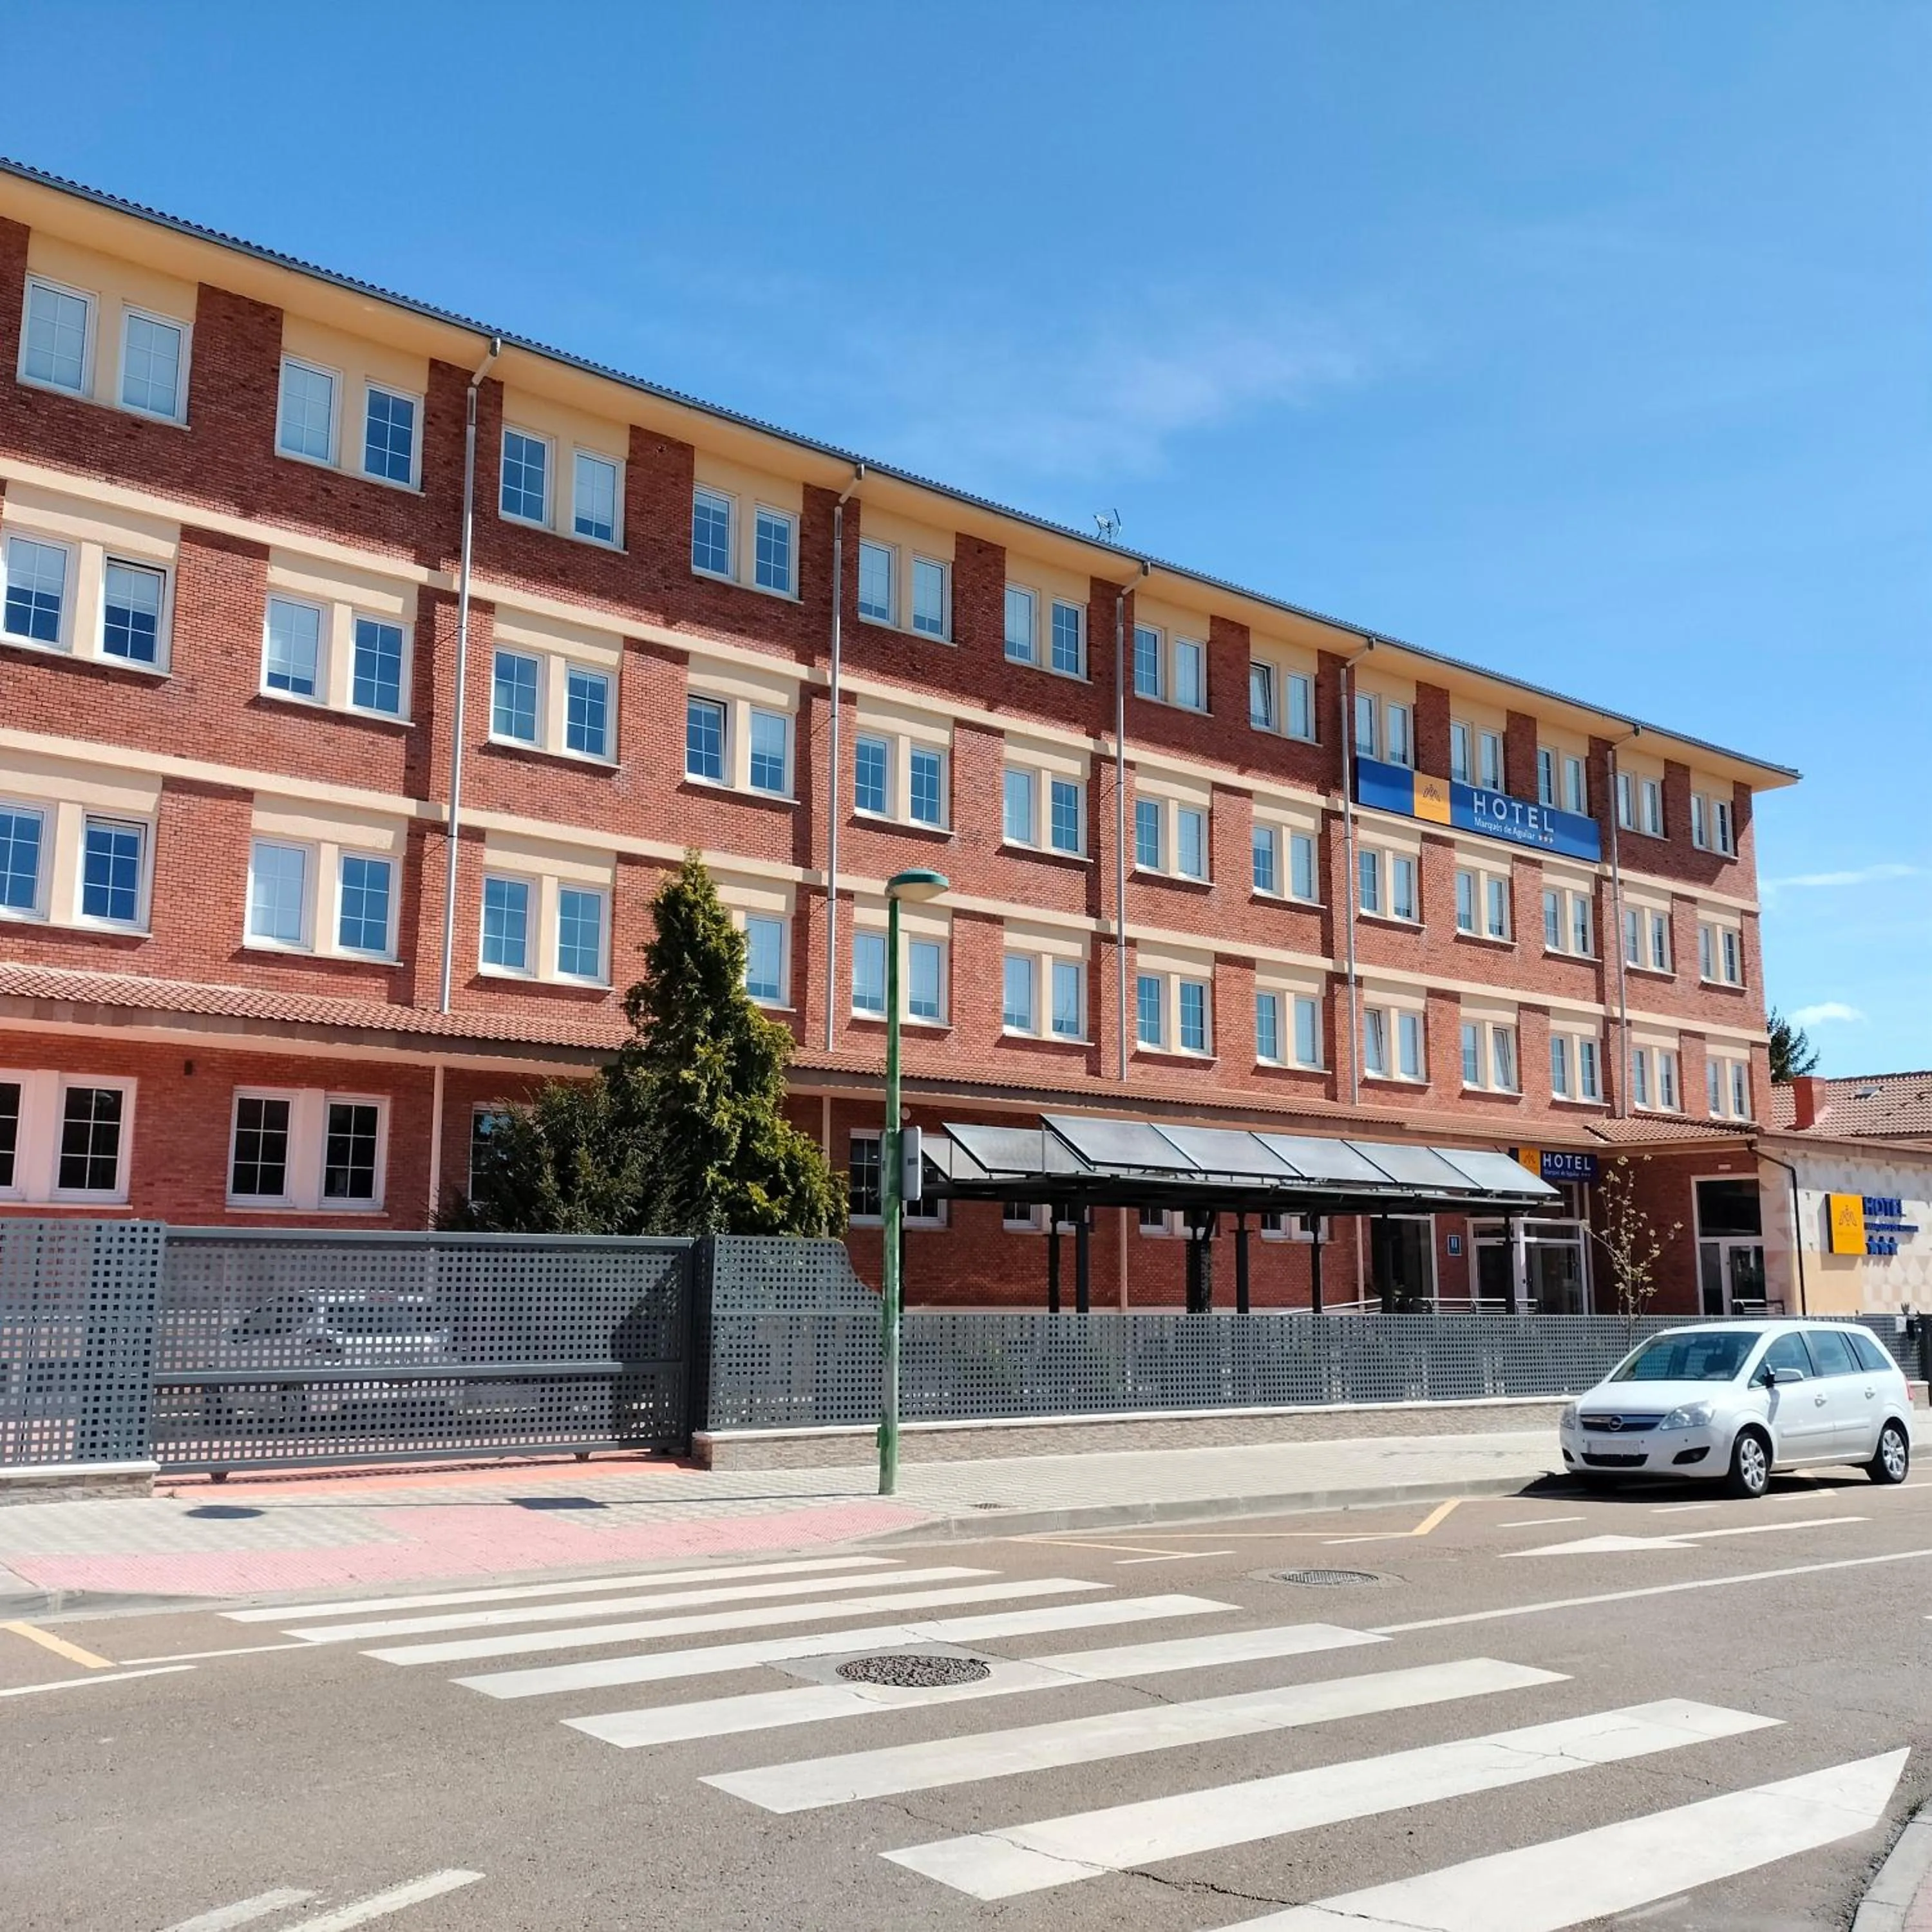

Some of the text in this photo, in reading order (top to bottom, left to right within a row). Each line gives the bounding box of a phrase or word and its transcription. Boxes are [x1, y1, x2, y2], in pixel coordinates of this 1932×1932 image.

[1473, 791, 1554, 833] HOTEL
[1504, 824, 1512, 834] de
[1513, 826, 1536, 840] Aguilar
[1543, 1153, 1591, 1170] HOTEL
